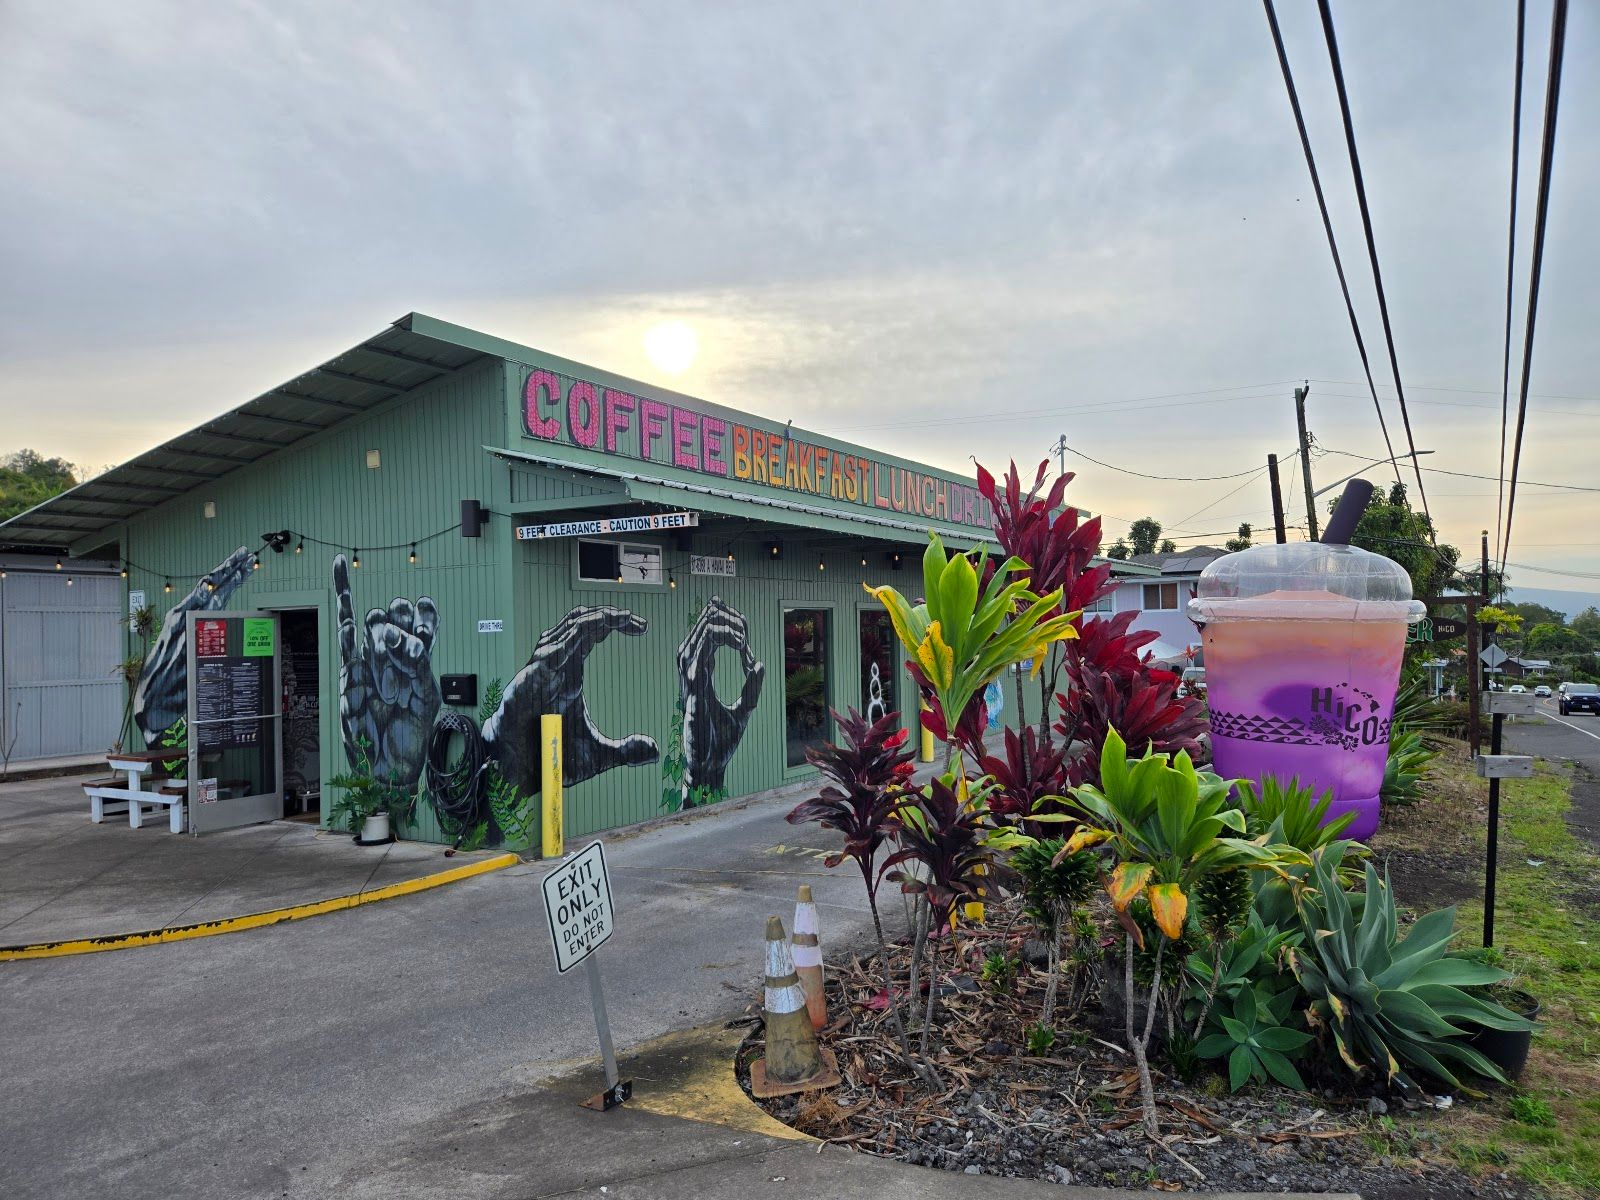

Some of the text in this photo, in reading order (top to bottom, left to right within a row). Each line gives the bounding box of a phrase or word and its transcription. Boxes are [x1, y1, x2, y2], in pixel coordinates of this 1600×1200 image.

[522, 369, 728, 476] COFFEE
[732, 423, 870, 505] BREAKFAST
[873, 462, 948, 520] LUNCH
[518, 527, 525, 538] 9
[549, 522, 602, 536] CLEARANCE
[609, 518, 651, 532] CAUTION
[653, 517, 660, 528] 9
[661, 515, 686, 527] FEET
[558, 859, 592, 900] EXIT
[557, 878, 601, 926] ONLY
[563, 902, 604, 943] DO NOT
[568, 920, 605, 956] ENTER
